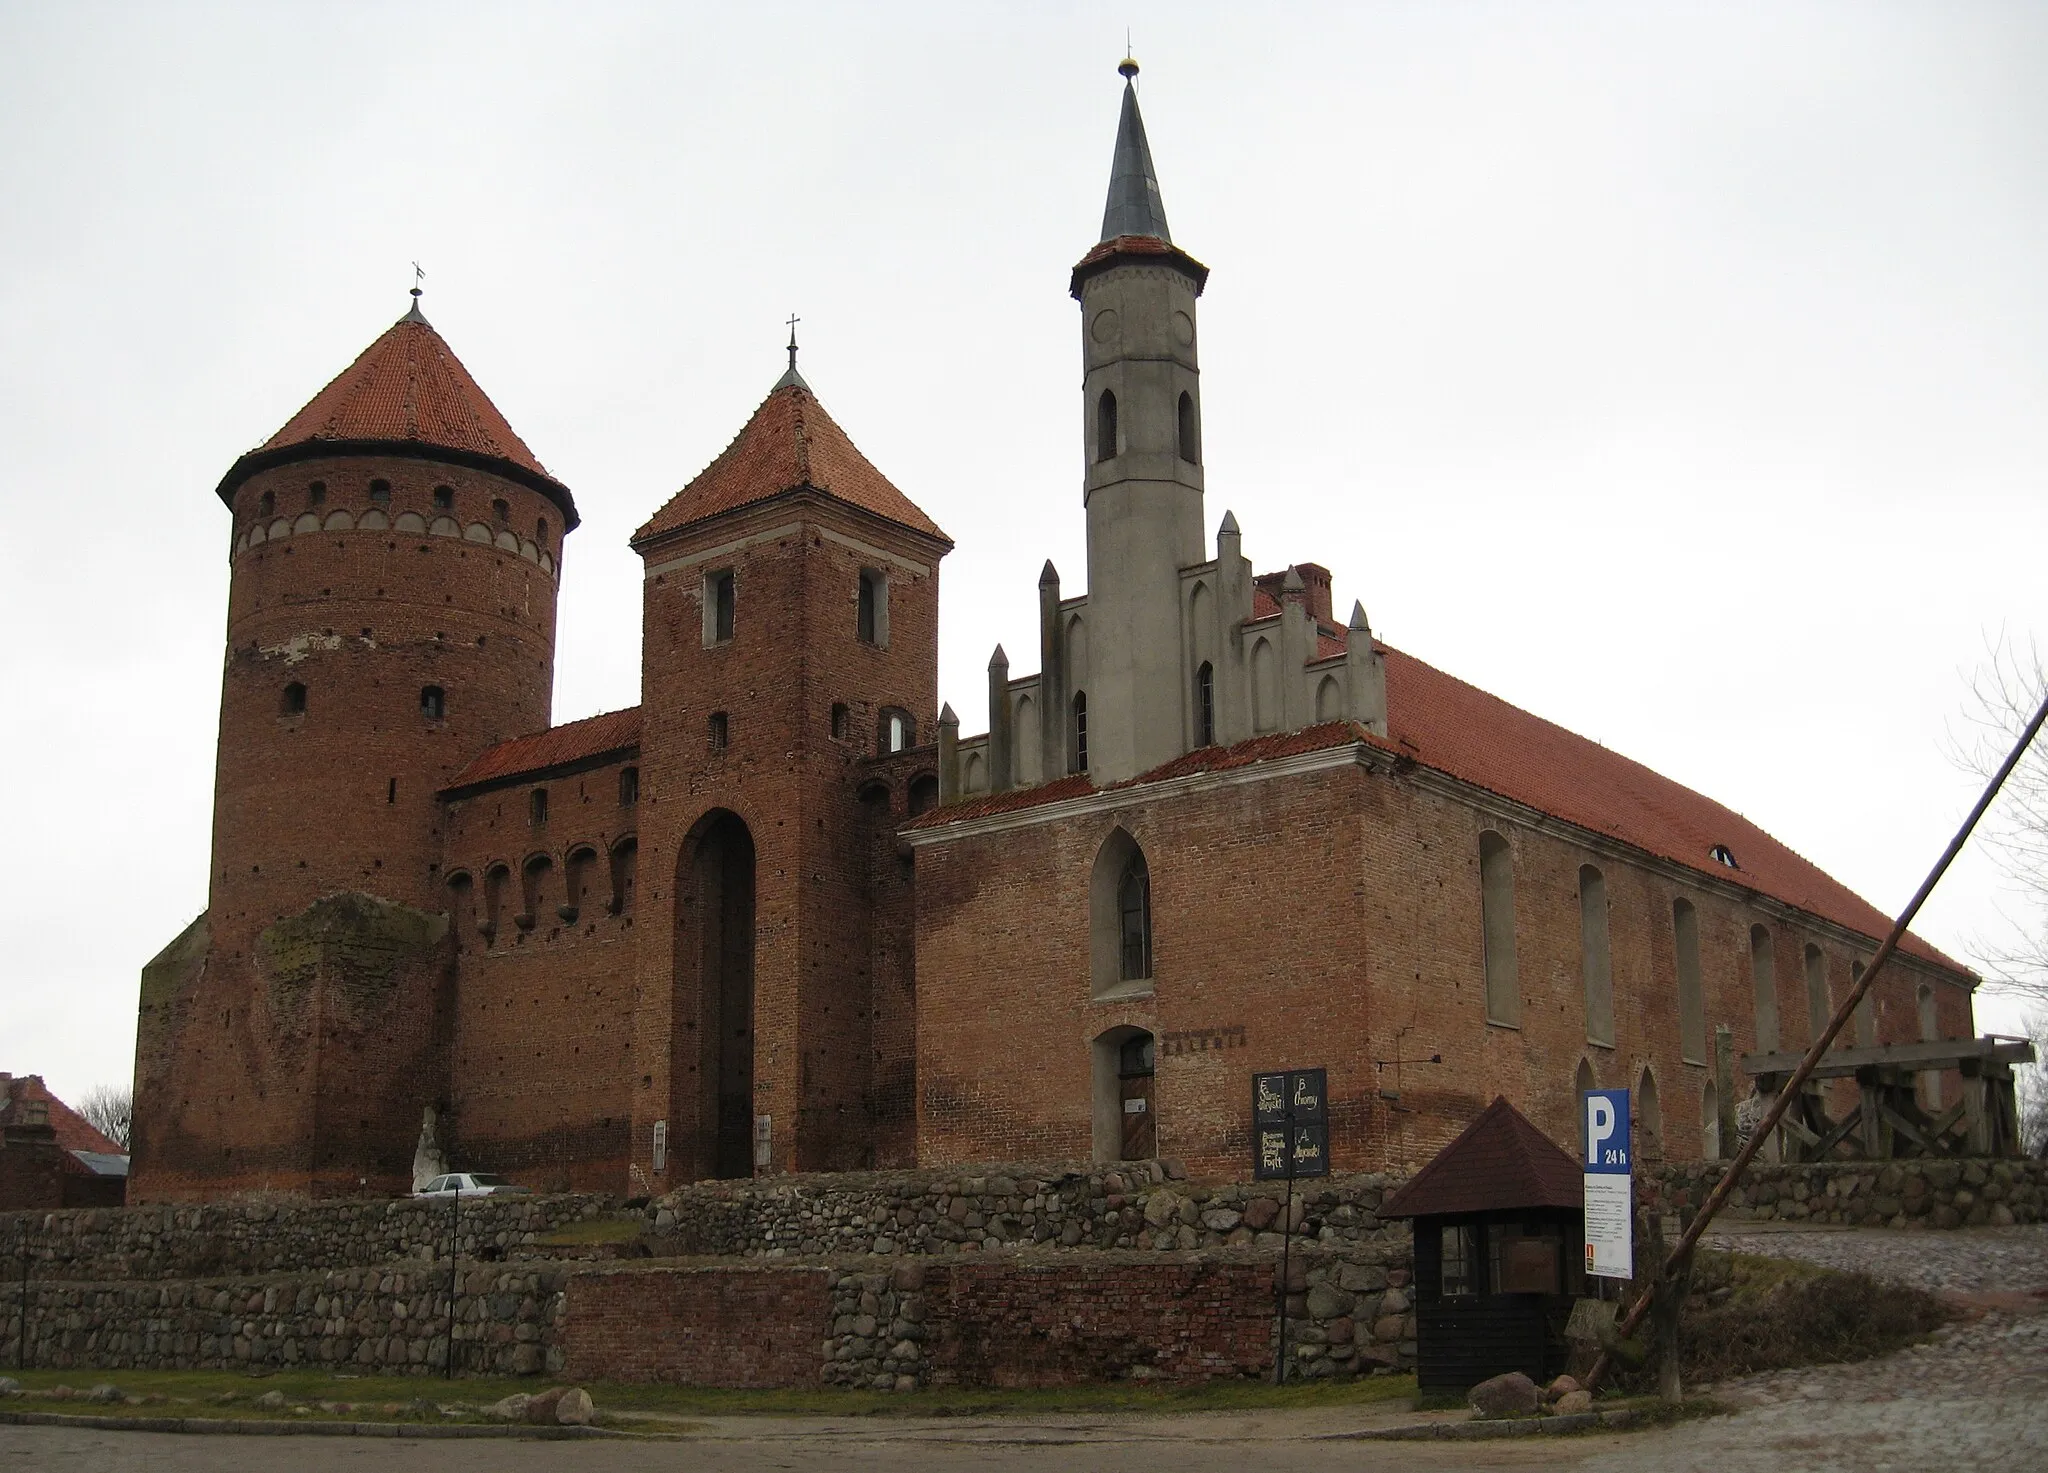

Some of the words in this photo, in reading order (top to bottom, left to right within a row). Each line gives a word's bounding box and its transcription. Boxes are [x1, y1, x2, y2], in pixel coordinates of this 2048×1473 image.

[1588, 1096, 1615, 1163] P
[1605, 1149, 1617, 1164] 24
[1620, 1149, 1626, 1164] h
